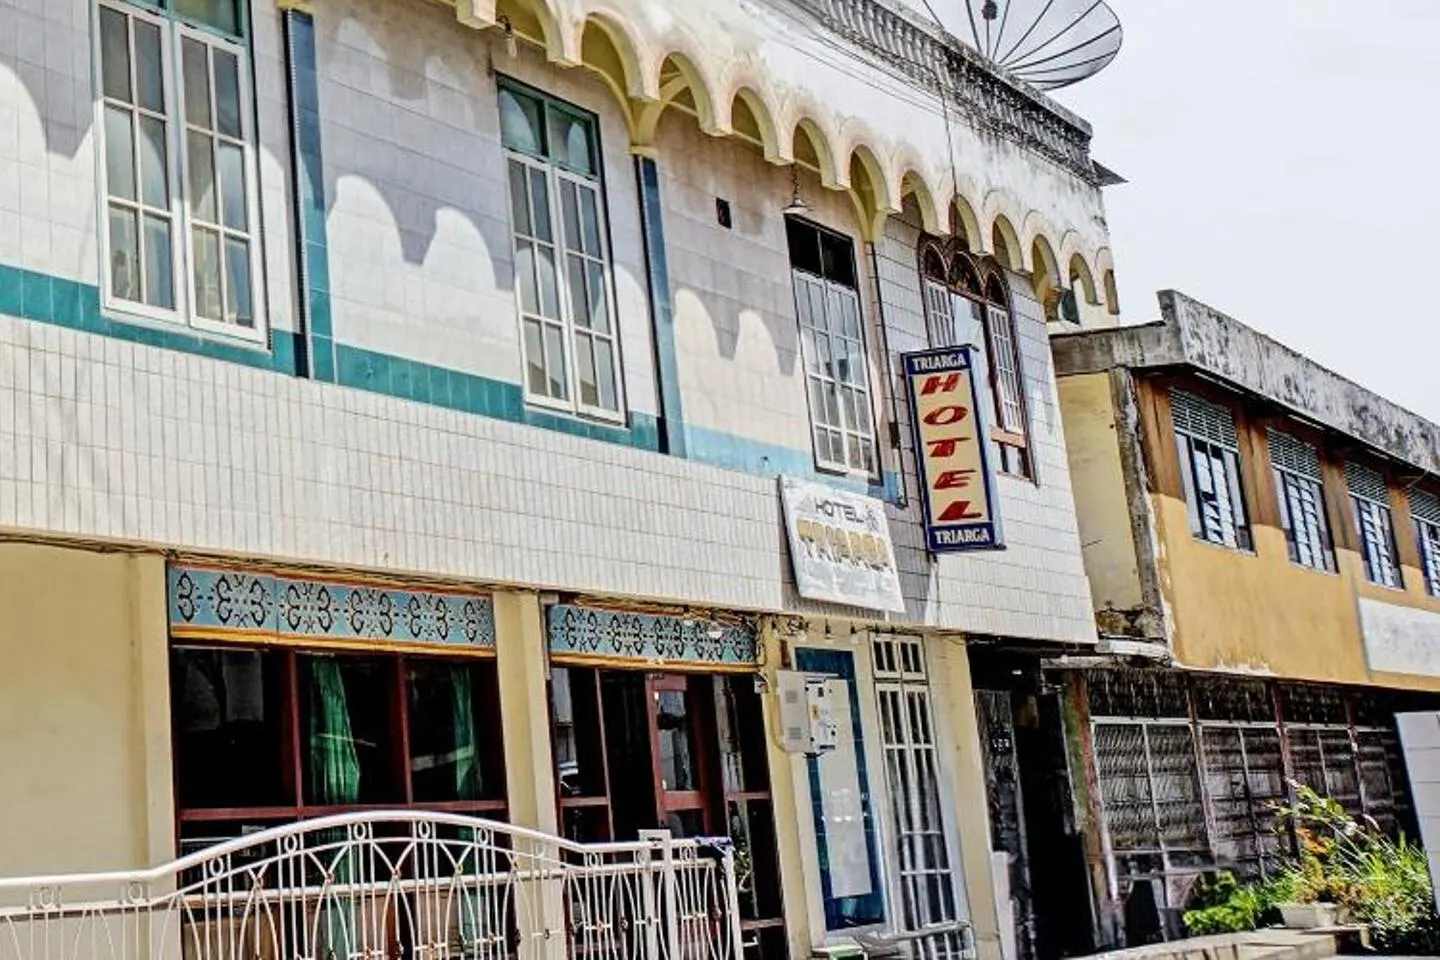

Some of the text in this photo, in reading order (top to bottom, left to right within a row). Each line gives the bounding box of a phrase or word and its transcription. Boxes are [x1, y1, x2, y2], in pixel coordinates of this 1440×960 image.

[912, 352, 967, 371] TRIARGA
[921, 372, 982, 520] HOTEL
[934, 527, 990, 544] TRIARGA
